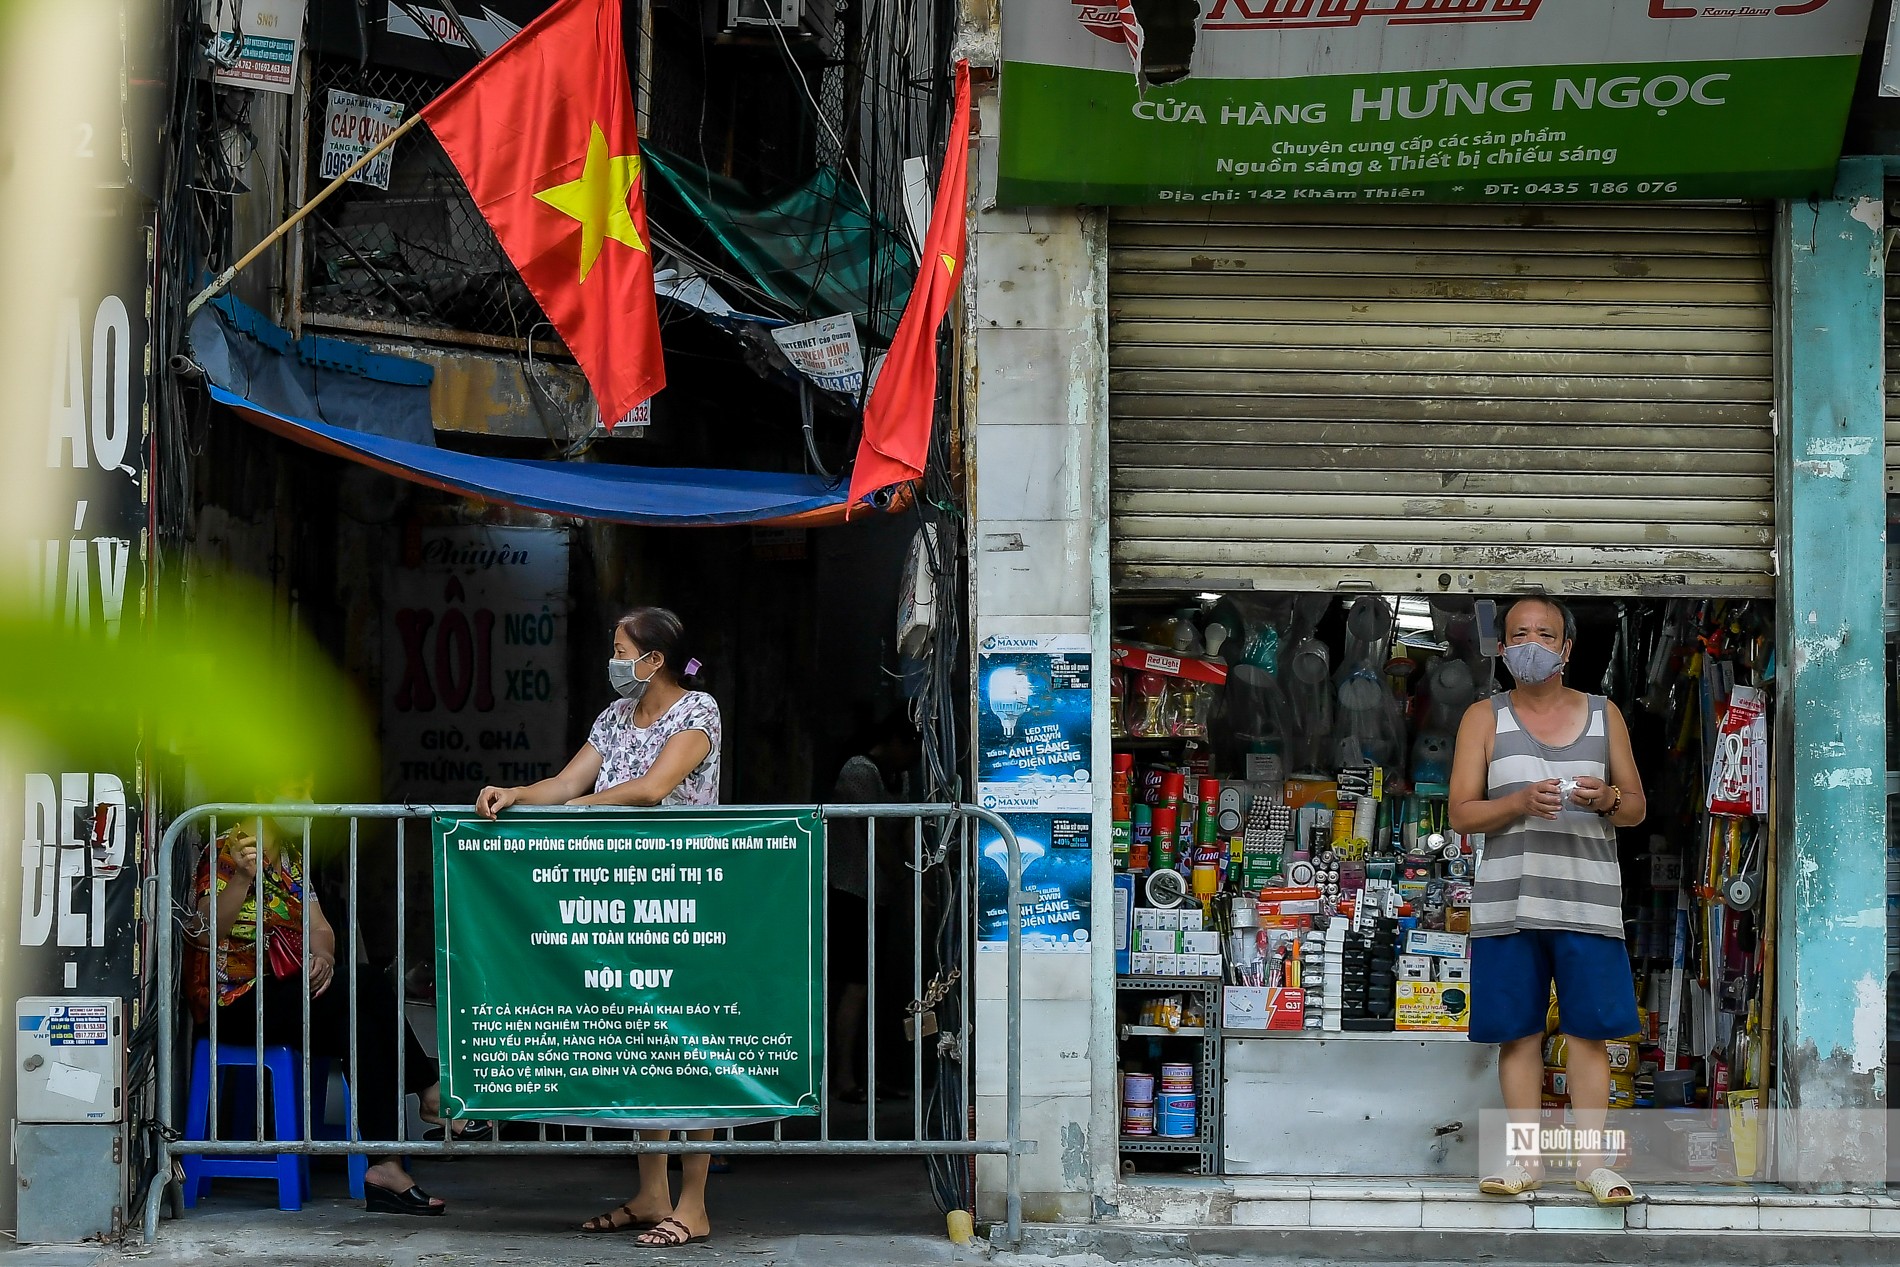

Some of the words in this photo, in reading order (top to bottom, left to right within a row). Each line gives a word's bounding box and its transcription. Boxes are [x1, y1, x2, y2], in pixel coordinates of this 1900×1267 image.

[1131, 98, 1207, 124] CỬA
[1220, 102, 1327, 126] HÀNG
[1350, 78, 1533, 123] HƯNG
[1551, 73, 1732, 117] NGỌC
[1271, 141, 1344, 157] Chuyên
[1348, 140, 1395, 154] cung
[1400, 135, 1433, 152] cấp
[1438, 131, 1468, 147] các
[1472, 130, 1506, 146] sản
[1510, 126, 1567, 146] phẩm
[1216, 157, 1297, 176] Nguồn
[1304, 156, 1363, 177] sáng
[1367, 159, 1382, 173] &
[1387, 150, 1452, 173] Thiết
[1457, 151, 1481, 170] bị
[1486, 146, 1553, 166] chiếu
[1558, 145, 1618, 165] sáng
[1158, 189, 1194, 203] Địa
[1201, 188, 1241, 201] chỉ:
[1247, 188, 1287, 199] 142
[1293, 187, 1358, 199] Khâm
[1362, 186, 1425, 199] Thiên
[1484, 184, 1519, 195] ĐT:
[1524, 182, 1579, 195] 0435
[1588, 181, 1629, 195] 186
[1636, 180, 1678, 194] 076
[504, 604, 555, 646] NGÔ
[394, 574, 497, 713] XÔI
[997, 639, 1039, 647] MAXWIN
[504, 660, 552, 702] XÉO
[1024, 726, 1041, 736] LED
[997, 798, 1039, 806] MAXWIN
[458, 839, 480, 850] BAN
[483, 836, 501, 851] CHỈ
[504, 839, 526, 853] ĐẠO
[528, 837, 565, 851] PHÒNG
[567, 835, 604, 851] CHỐNG
[607, 839, 633, 853] DỊCH
[635, 838, 683, 851] COVID-19
[685, 835, 729, 850] PHƯỜNG
[731, 836, 763, 850] KHÂM
[766, 835, 797, 850] THIÊN
[532, 864, 569, 883] CHỐT
[573, 867, 610, 885] THỰC
[614, 866, 648, 885] HIỆN
[651, 863, 676, 882] CHỈ
[679, 867, 702, 885] THỊ
[706, 867, 724, 882] 16
[559, 896, 626, 924] VÙNG
[633, 899, 697, 924] XANH
[530, 930, 568, 946] (VÙNG
[571, 932, 588, 945] AN
[592, 930, 624, 945] TOÀN
[627, 930, 670, 945] KHÔNG
[673, 929, 690, 945] CÓ
[693, 931, 727, 947] DỊCH)
[584, 966, 623, 992] NỘI
[629, 969, 674, 990] QUY
[472, 1003, 493, 1015] TẤT
[495, 1003, 512, 1015] CẢ
[514, 1003, 554, 1015] KHÁCH
[557, 1005, 573, 1015] RA
[576, 1003, 599, 1015] VÀO
[628, 1002, 654, 1015] PHẢI
[657, 1005, 683, 1015] KHAI
[686, 1003, 710, 1015] BÁO
[713, 1005, 721, 1015] Y
[1285, 1001, 1301, 1010] Q3T
[472, 1021, 502, 1032] THỰC
[505, 1020, 532, 1032] HIỆN
[534, 1019, 580, 1031] NGHIÊM
[583, 1019, 622, 1030] THÔNG
[625, 1019, 651, 1032] ĐIỆP
[653, 1020, 668, 1030] 5K
[472, 1037, 497, 1046] NHU
[499, 1034, 522, 1047] YẾU
[524, 1032, 560, 1047] PHẨM,
[562, 1034, 595, 1046] HÀNG
[598, 1034, 622, 1046] HÓA
[625, 1033, 645, 1046] CHỈ
[647, 1034, 679, 1047] NHẬN
[681, 1036, 699, 1048] TẠI
[702, 1034, 726, 1045] BÀN
[728, 1035, 759, 1047] TRỰC
[761, 1033, 793, 1046] CHỐT
[473, 1051, 509, 1062] NGƯỜI
[511, 1050, 535, 1062] DÂN
[537, 1049, 570, 1062] SỐNG
[572, 1051, 613, 1061] TRONG
[615, 1049, 648, 1061] VÙNG
[650, 1051, 681, 1061] XANH
[709, 1048, 736, 1061] PHẢI
[738, 1049, 755, 1061] CÓ
[757, 1049, 766, 1061] Ý
[768, 1049, 799, 1061] THỨC
[473, 1067, 488, 1079] TỰ
[490, 1065, 515, 1078] BẢO
[517, 1066, 532, 1079] VỆ
[534, 1066, 567, 1079] MÌNH,
[569, 1067, 589, 1077] GIA
[591, 1065, 620, 1077] ĐÌNH
[622, 1064, 638, 1076] VÀ
[640, 1064, 674, 1078] CỘNG
[714, 1063, 745, 1076] CHẤP
[748, 1064, 779, 1077] HÀNH
[474, 1082, 513, 1093] THÔNG
[515, 1081, 542, 1094] ĐIỆP
[544, 1083, 559, 1093] 5K
